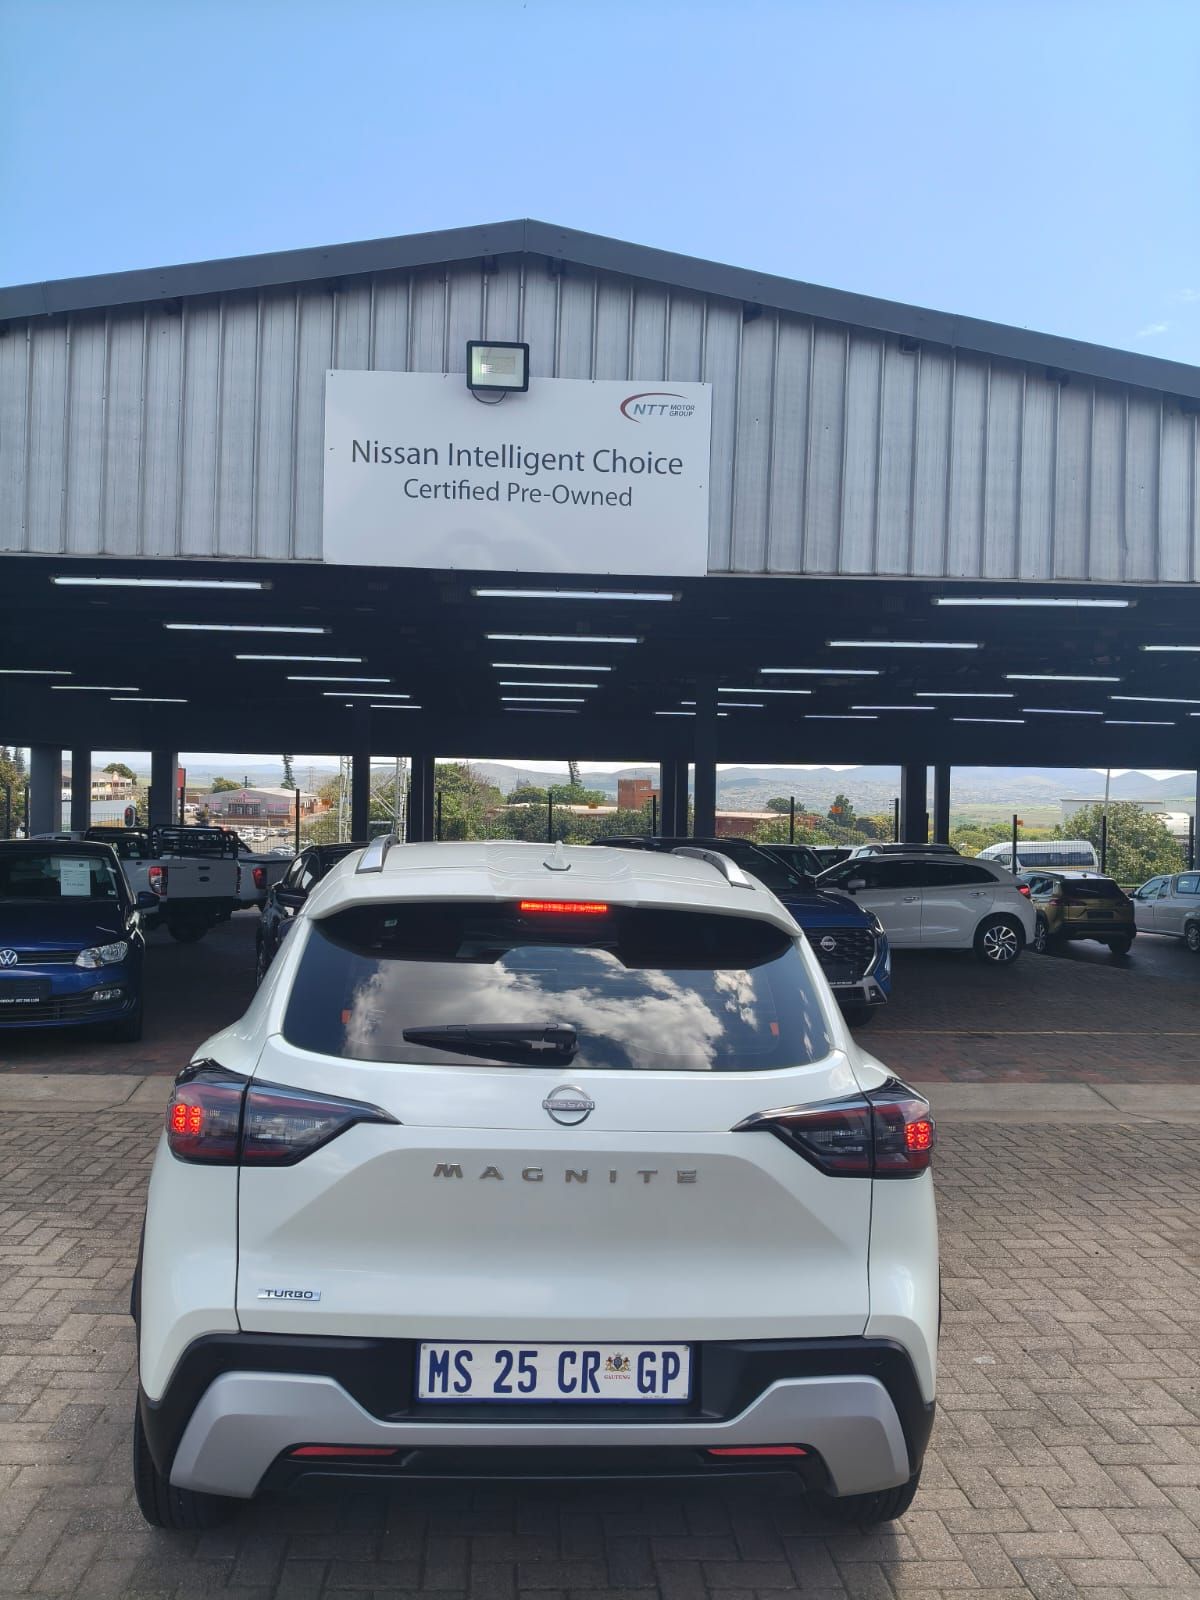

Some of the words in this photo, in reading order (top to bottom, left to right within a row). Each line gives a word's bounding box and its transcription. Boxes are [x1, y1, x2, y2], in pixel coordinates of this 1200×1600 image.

[633, 403, 669, 416] NTT
[352, 439, 439, 466] Nissan
[449, 442, 585, 476] Intelligent
[593, 448, 683, 475] Choice
[404, 478, 500, 502] Certified
[507, 482, 632, 507] Pre-Owned
[543, 1100, 595, 1109] NISSAN
[433, 1163, 697, 1184] MAGNITE
[265, 1289, 313, 1299] TURBO
[428, 1349, 473, 1393] MS
[493, 1349, 538, 1393] 25
[557, 1350, 601, 1394] CR
[637, 1351, 680, 1394] GP
